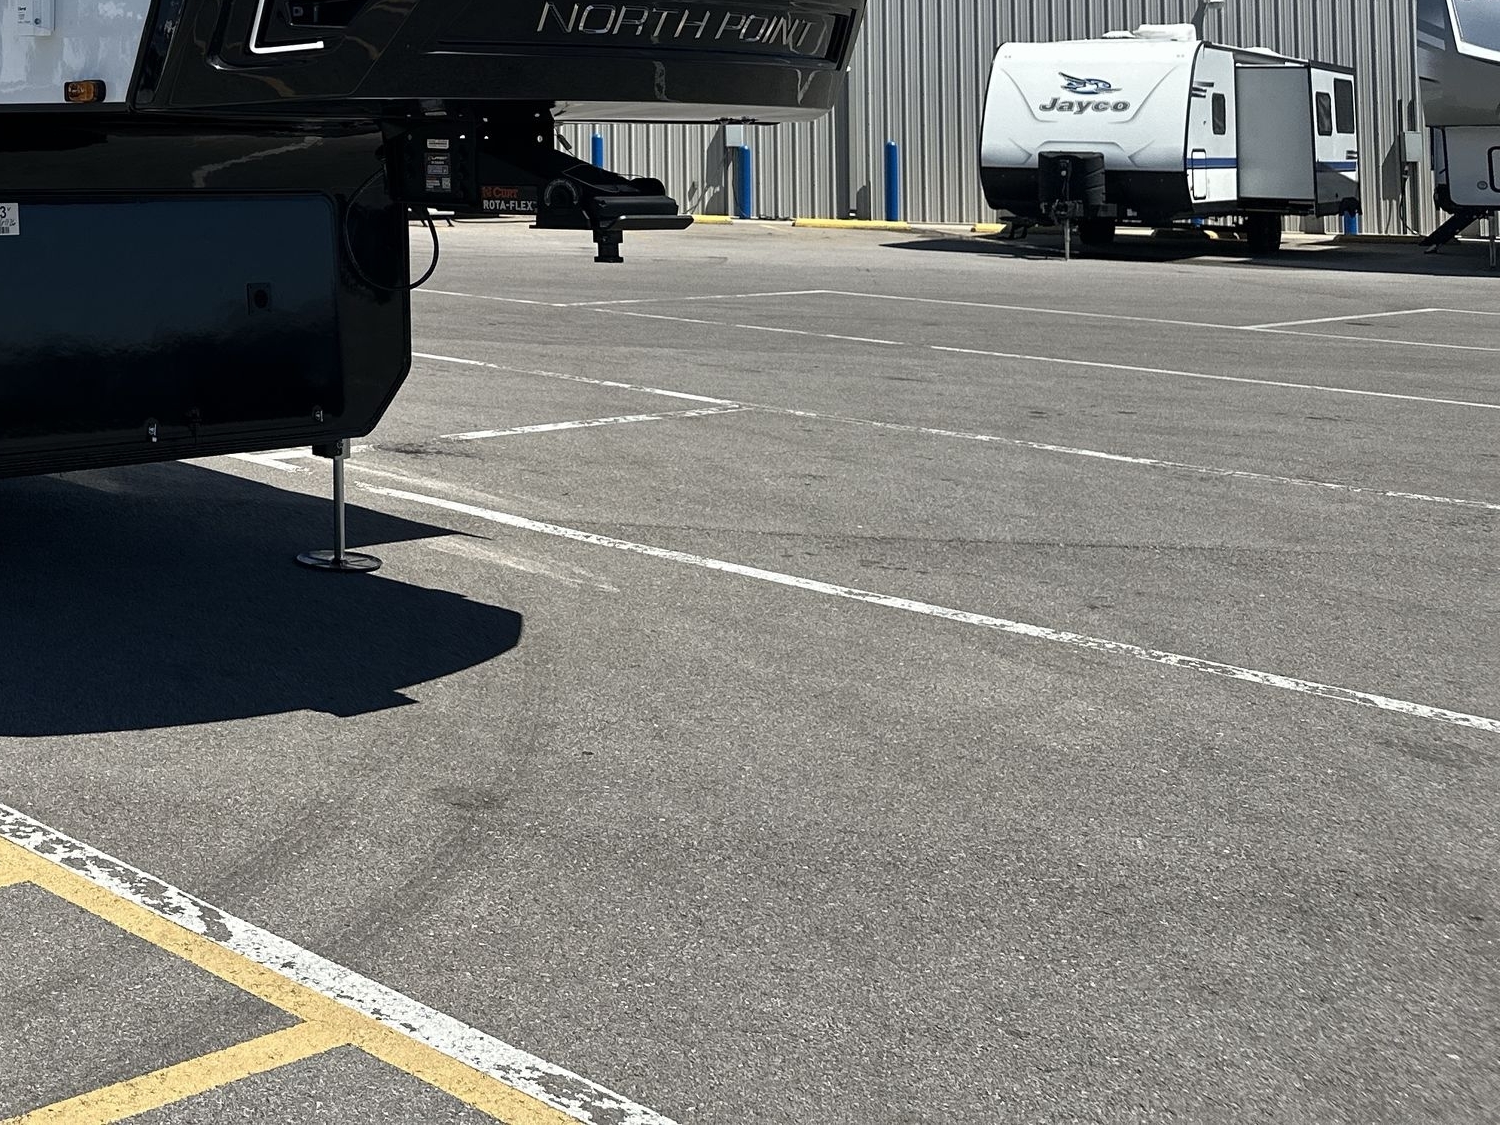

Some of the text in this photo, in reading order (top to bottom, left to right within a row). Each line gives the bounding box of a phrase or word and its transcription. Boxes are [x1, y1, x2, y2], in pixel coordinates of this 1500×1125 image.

[536, 1, 818, 48] NORTH POINT
[1039, 97, 1131, 115] Jayco
[483, 199, 533, 211] ROTA-FLEX
